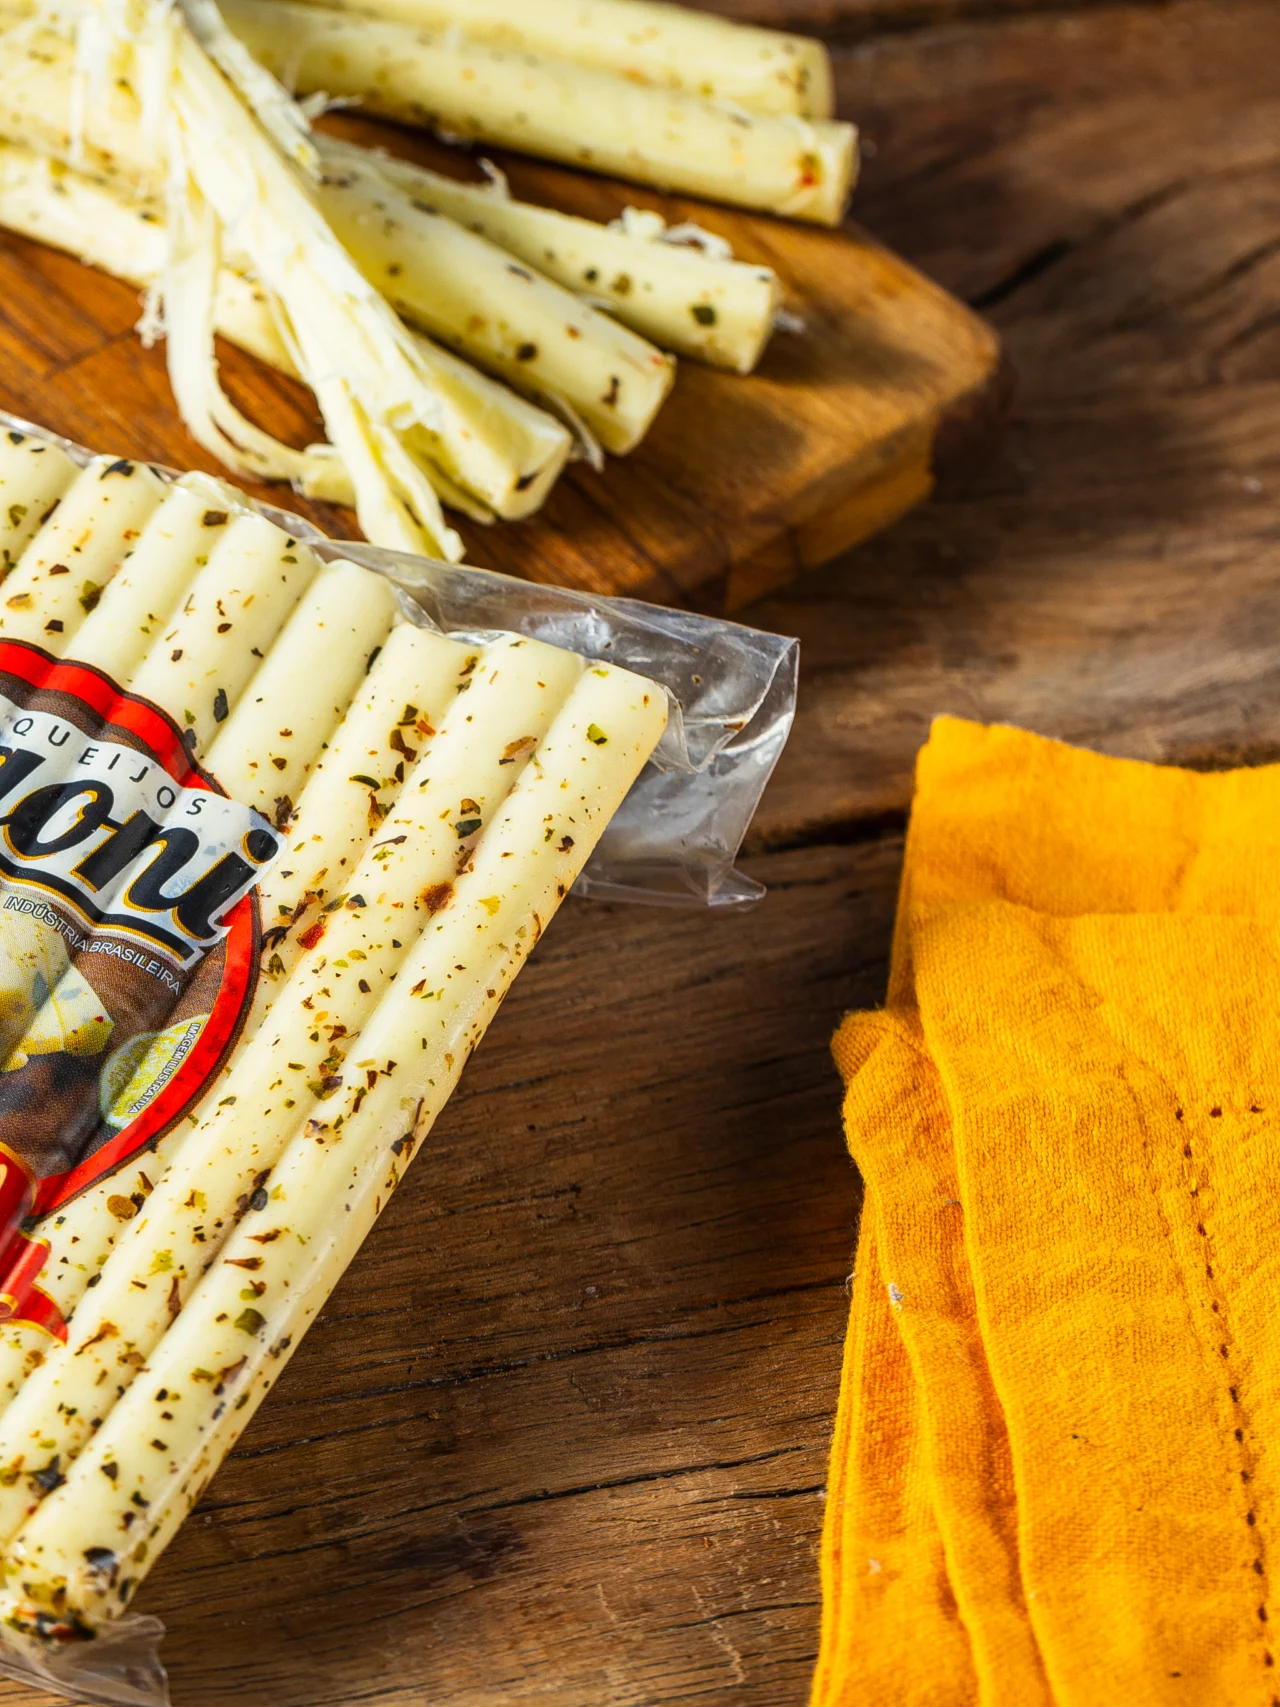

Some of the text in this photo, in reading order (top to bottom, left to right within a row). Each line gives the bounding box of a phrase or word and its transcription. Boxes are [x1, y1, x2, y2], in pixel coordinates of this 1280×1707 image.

[12, 717, 207, 815] QUEIJOS
[3, 896, 181, 996] INDÚSTRIA BRASILEIRA
[128, 1023, 201, 1114] IMAGEM ILUSTRATIVA
